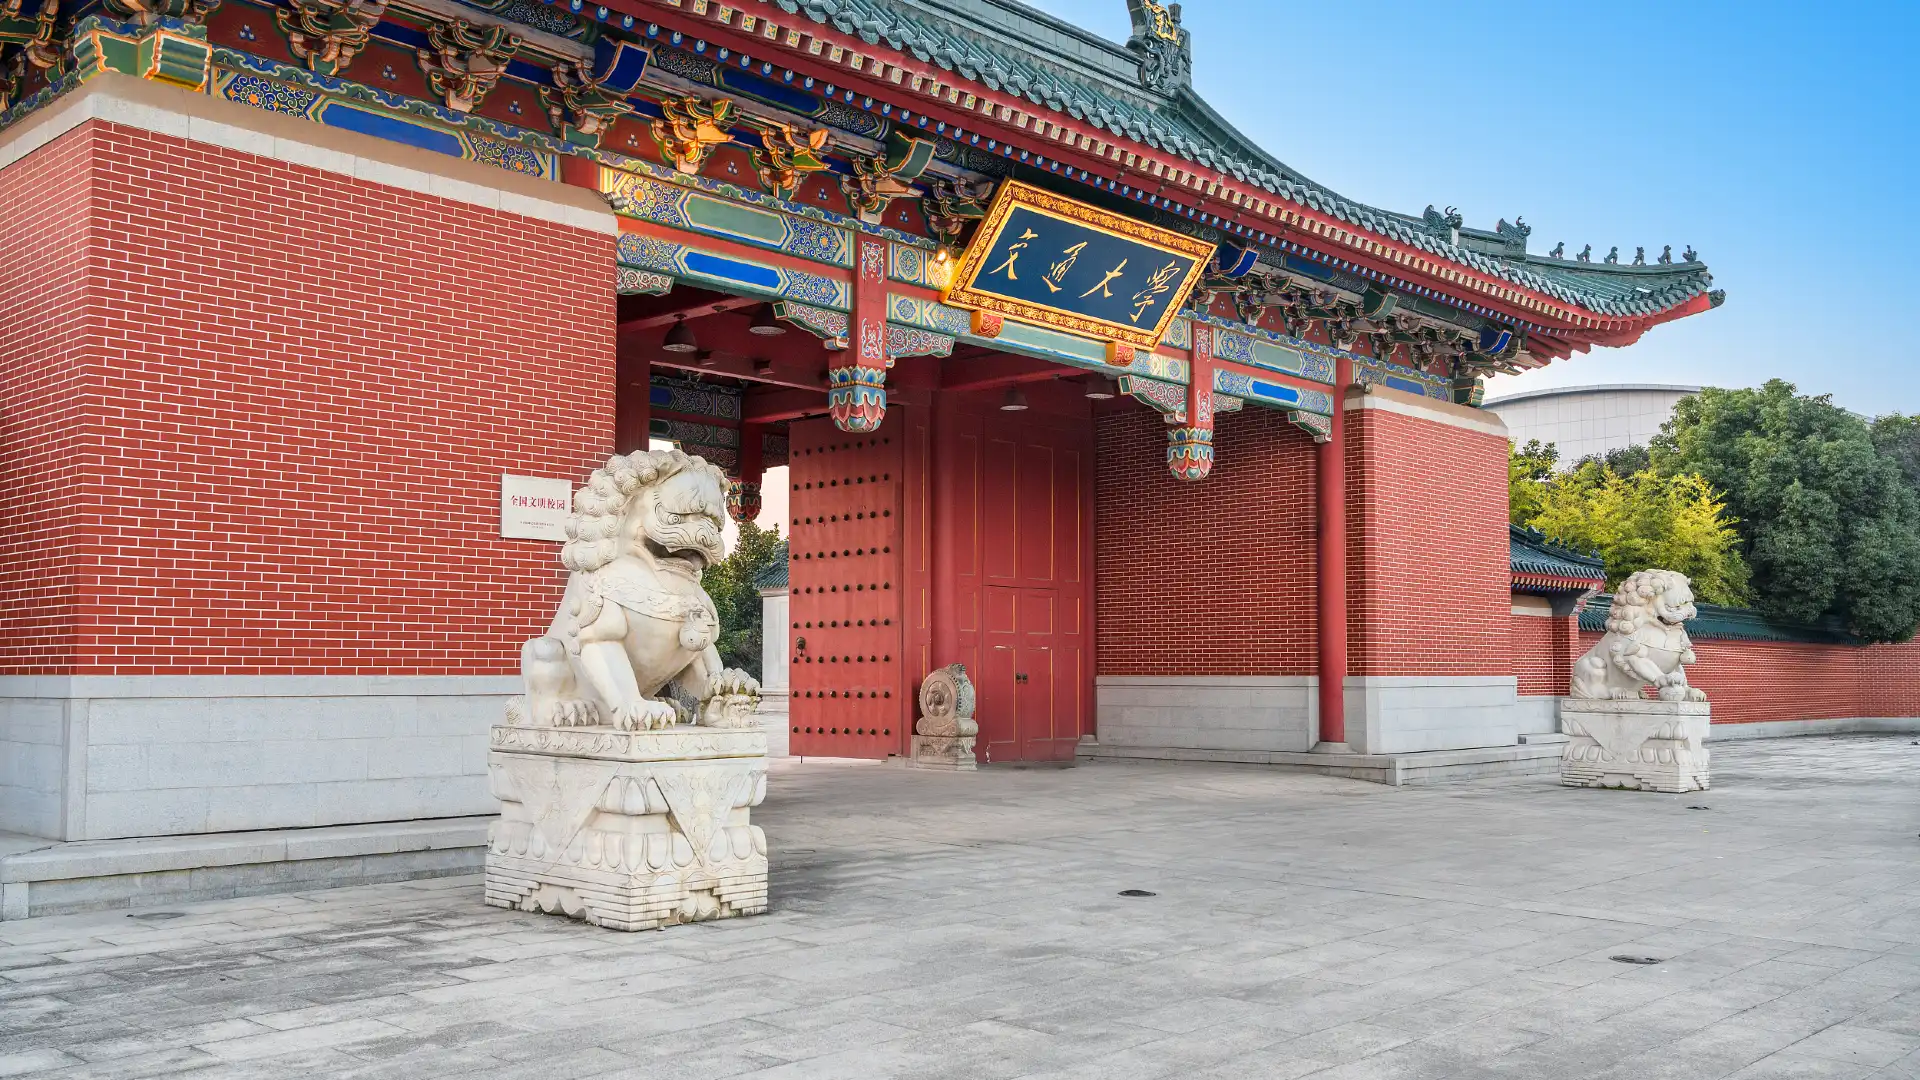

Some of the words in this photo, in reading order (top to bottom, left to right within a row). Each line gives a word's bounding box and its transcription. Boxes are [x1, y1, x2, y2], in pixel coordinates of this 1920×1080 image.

[510, 495, 565, 510] 全国文明校园
